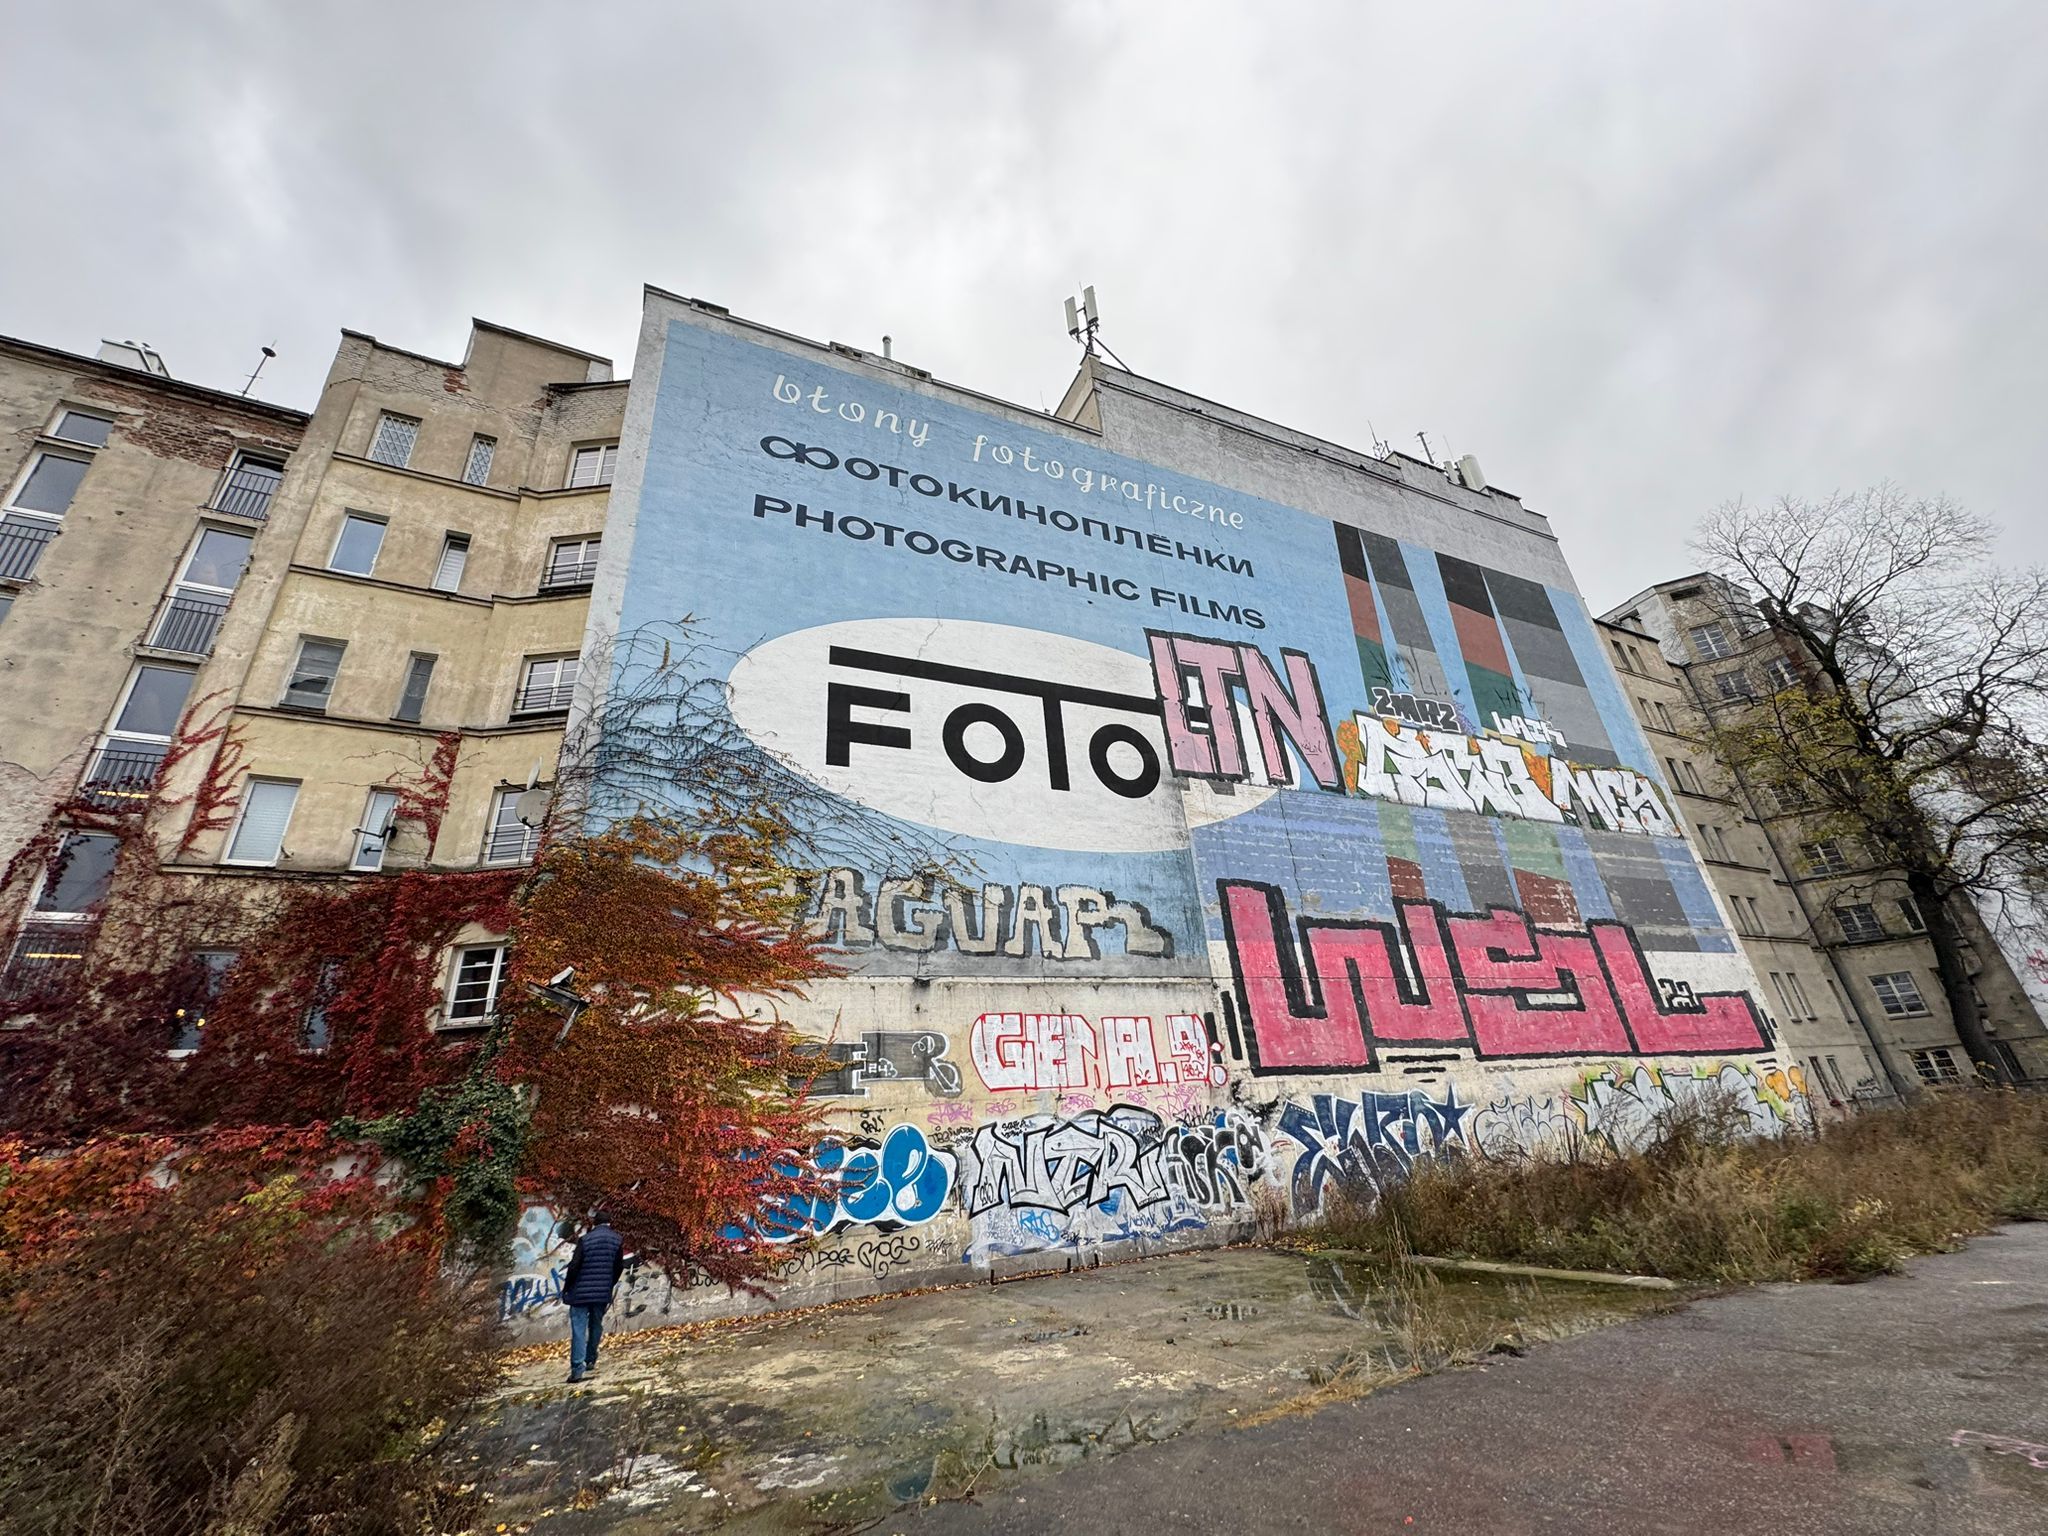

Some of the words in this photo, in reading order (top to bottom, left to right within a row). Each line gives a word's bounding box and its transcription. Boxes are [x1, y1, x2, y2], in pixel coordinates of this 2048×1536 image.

[759, 435, 1255, 578] ФОТОКИНОПЛЁНКИ
[972, 434, 1244, 530] fotograficzne
[753, 494, 1140, 602] PHOTOGRAPHIC
[1151, 588, 1267, 630] FILMS
[825, 645, 1235, 798] FOTO
